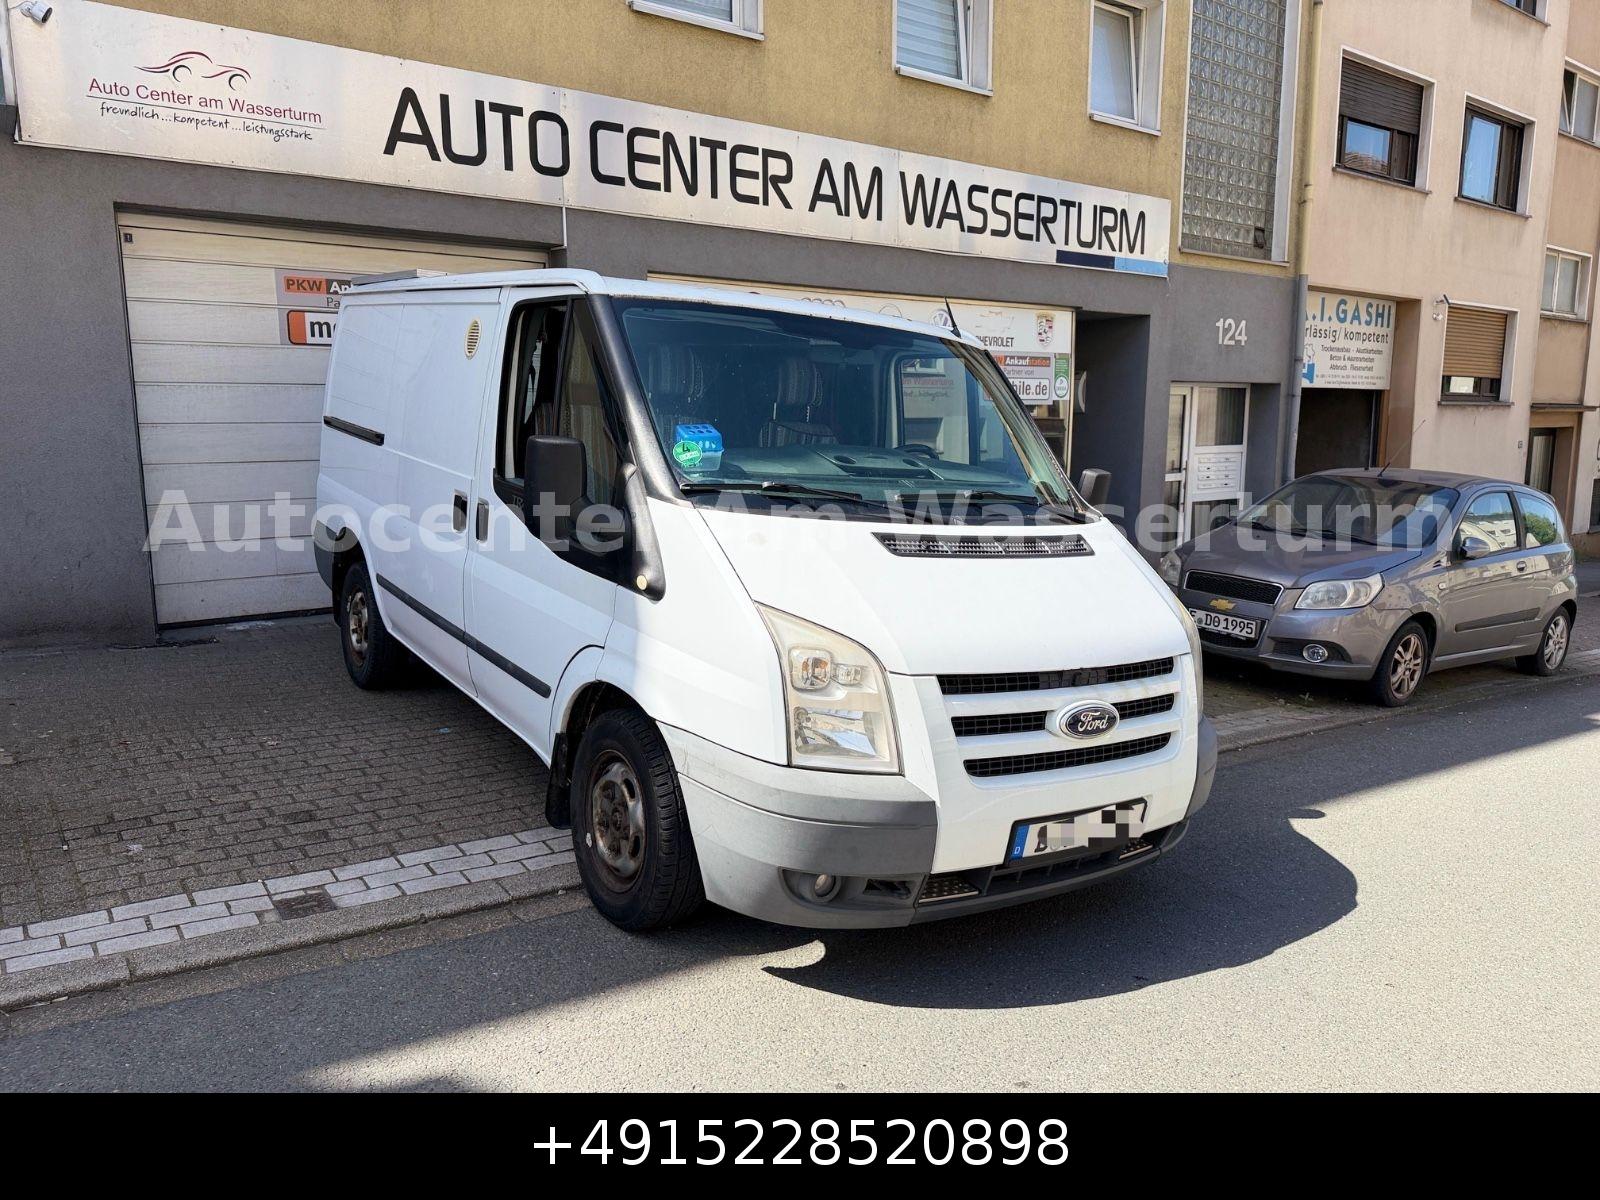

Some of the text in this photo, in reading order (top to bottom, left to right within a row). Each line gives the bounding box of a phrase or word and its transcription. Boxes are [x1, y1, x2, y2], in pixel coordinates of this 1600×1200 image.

[88, 78, 322, 124] Auto Center am Wasserturm
[384, 87, 1146, 255] AUTO CENTER AM WASSERTURM
[286, 278, 323, 292] PKW
[1305, 297, 1392, 329] .I.GASHI
[310, 320, 337, 339] m
[1216, 318, 1248, 346] 124
[1344, 327, 1389, 345] kompetent
[1223, 618, 1254, 635] 1995
[1078, 711, 1109, 733] Ford
